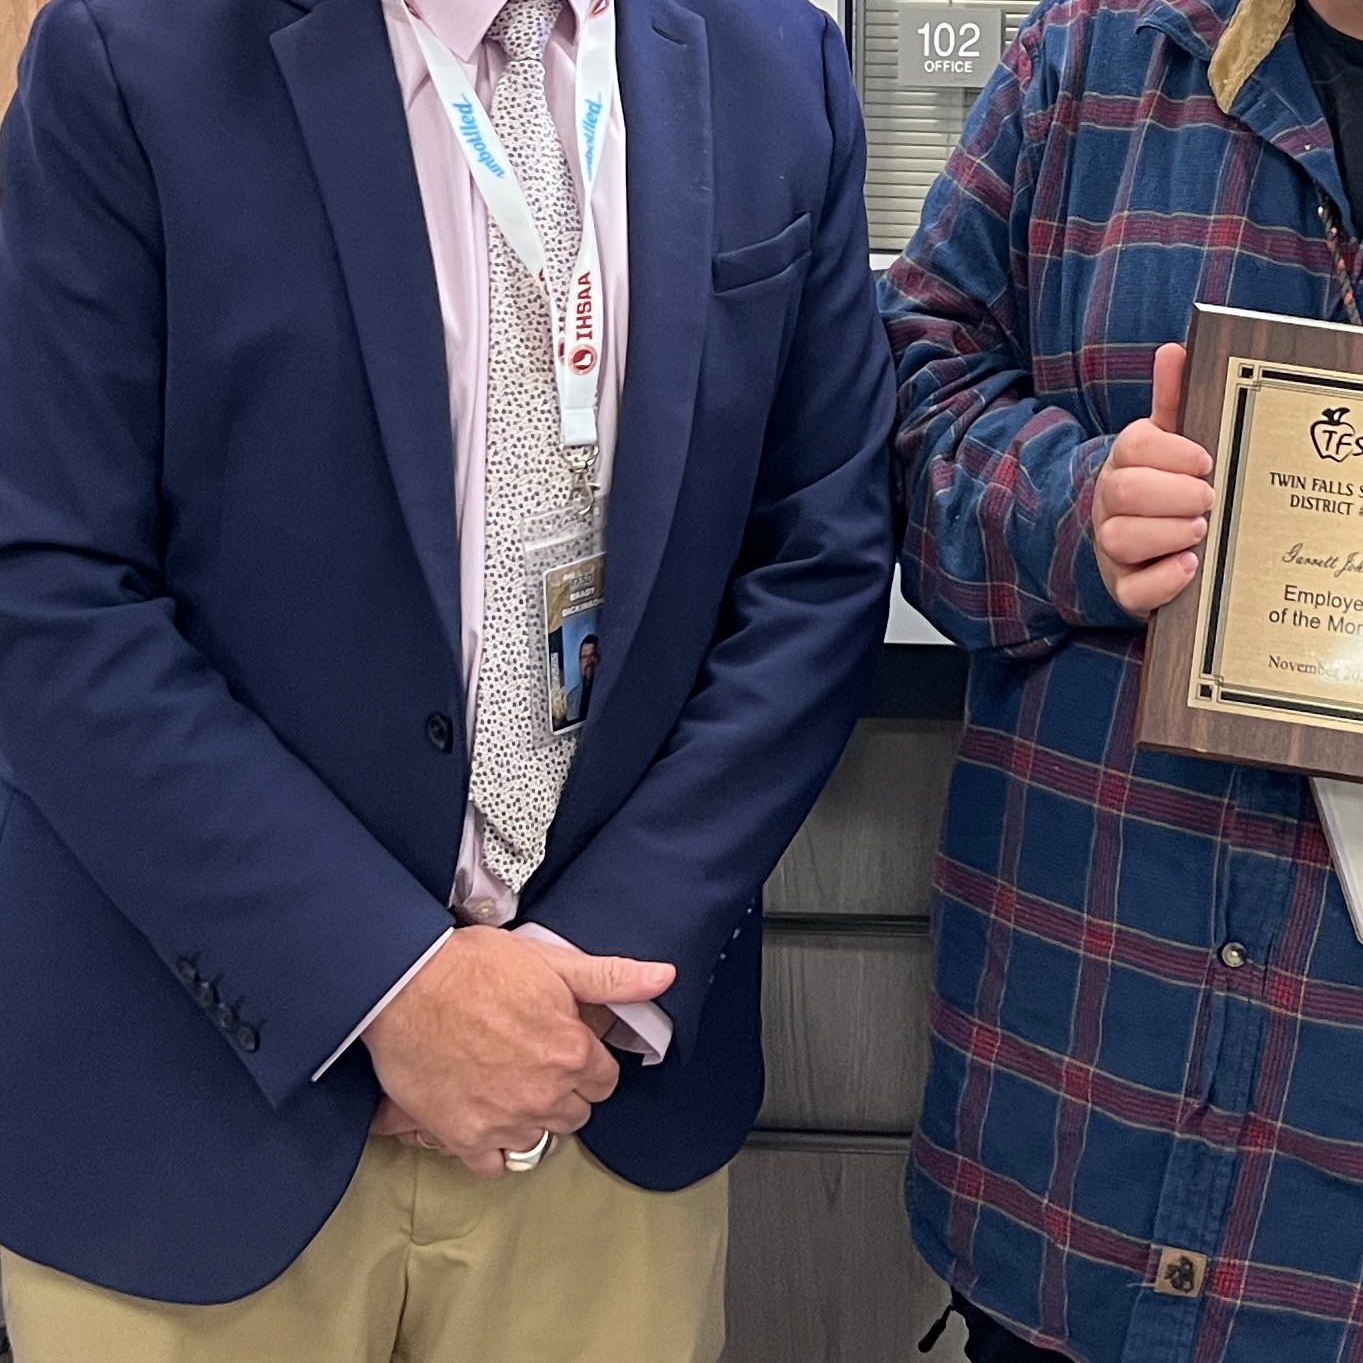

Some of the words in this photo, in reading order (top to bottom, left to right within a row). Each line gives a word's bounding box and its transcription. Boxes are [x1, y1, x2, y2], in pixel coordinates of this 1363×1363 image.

[917, 22, 981, 57] 102
[924, 60, 974, 73] OFFICE
[576, 271, 593, 341] IHSAA
[1269, 472, 1307, 490] TWIN
[1311, 477, 1354, 497] FALLS
[1290, 494, 1354, 515] DISTRICT
[1268, 608, 1289, 624] of
[1292, 610, 1322, 629] the
[1268, 654, 1341, 680] November
